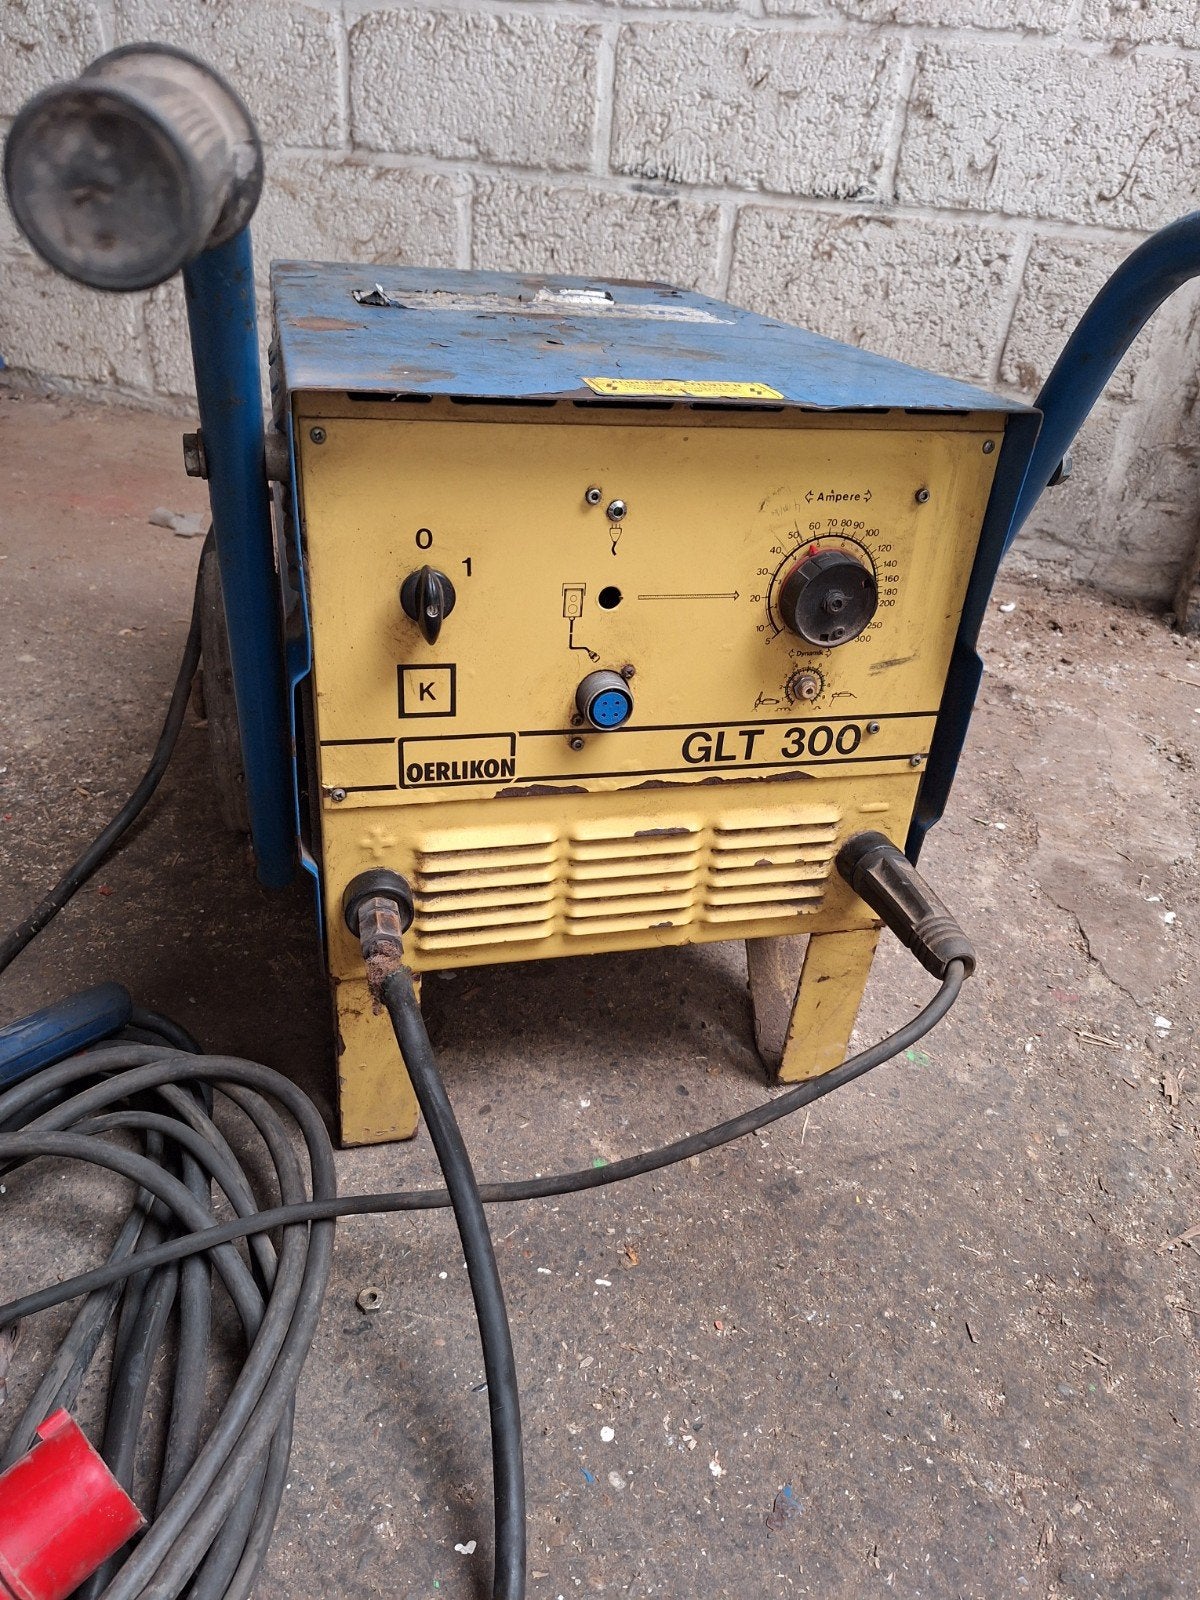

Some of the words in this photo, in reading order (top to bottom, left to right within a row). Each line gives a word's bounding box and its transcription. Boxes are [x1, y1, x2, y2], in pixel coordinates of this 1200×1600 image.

[817, 492, 861, 503] Ampere
[808, 522, 821, 530] 60
[827, 519, 838, 527] 70
[841, 519, 853, 527] 80
[853, 521, 865, 530] 90
[788, 531, 800, 540] 50
[865, 529, 880, 537] 100
[415, 528, 433, 550] 0
[769, 546, 782, 554] 40
[877, 544, 892, 552] 120
[461, 557, 472, 577] 1
[883, 560, 897, 568] 140
[756, 567, 769, 576] 30
[884, 575, 900, 583] 160
[883, 588, 898, 596] 180
[749, 594, 761, 603] 20
[756, 624, 765, 632] 10
[765, 637, 771, 645] 5
[854, 635, 872, 643] 300
[419, 682, 437, 701] K
[681, 729, 765, 764] GLT
[781, 724, 862, 759] 300
[406, 758, 516, 783] OERLIKON
